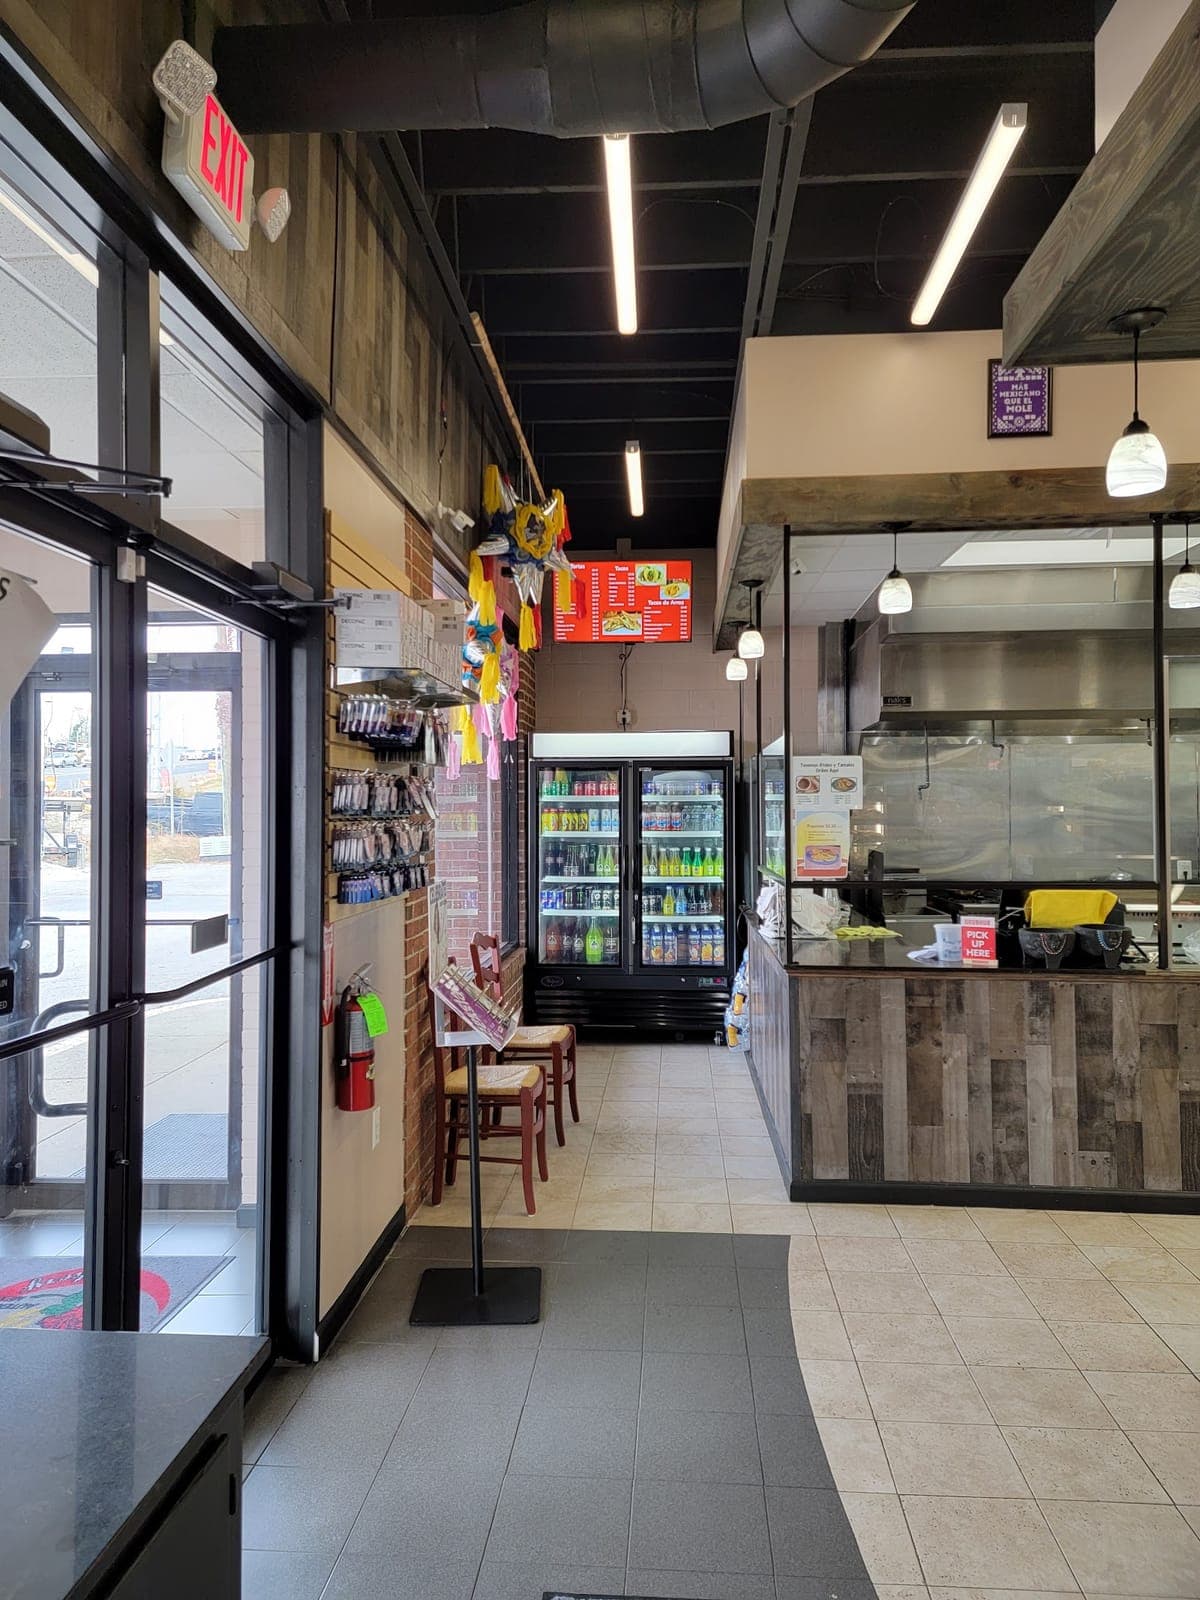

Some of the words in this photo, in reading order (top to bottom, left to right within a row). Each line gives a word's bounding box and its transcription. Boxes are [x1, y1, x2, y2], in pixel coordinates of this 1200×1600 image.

[201, 94, 249, 223] EXIT
[999, 390, 1041, 398] MEXICANO
[1004, 397, 1021, 405] QUE
[1006, 404, 1033, 413] MOLE
[966, 930, 989, 939] PICK
[971, 940, 985, 948] UP
[966, 949, 991, 958] HERE
